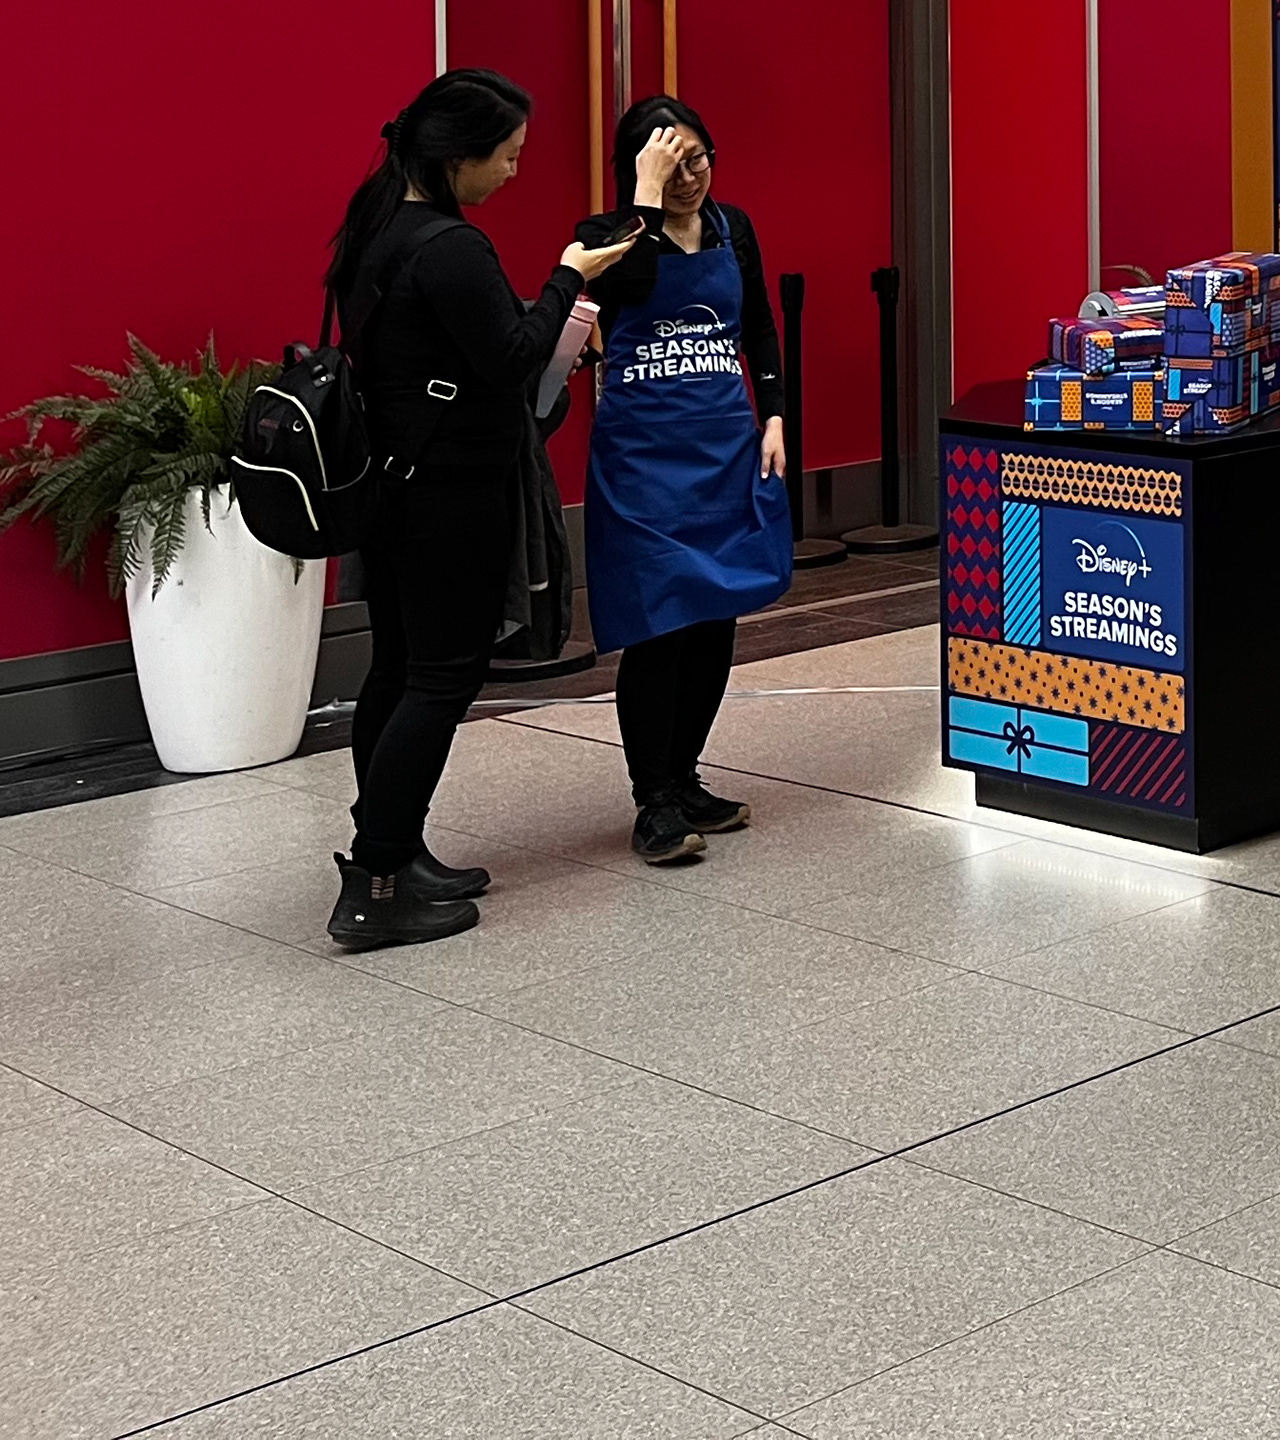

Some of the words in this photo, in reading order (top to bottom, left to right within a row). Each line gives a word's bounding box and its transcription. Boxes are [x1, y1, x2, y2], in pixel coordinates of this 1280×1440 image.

[653, 319, 726, 337] Disney+
[635, 338, 736, 361] SEASON'S
[1072, 538, 1152, 586] Disney+
[1064, 591, 1162, 627] SEASON'S
[1050, 615, 1177, 656] STREAMINGS
